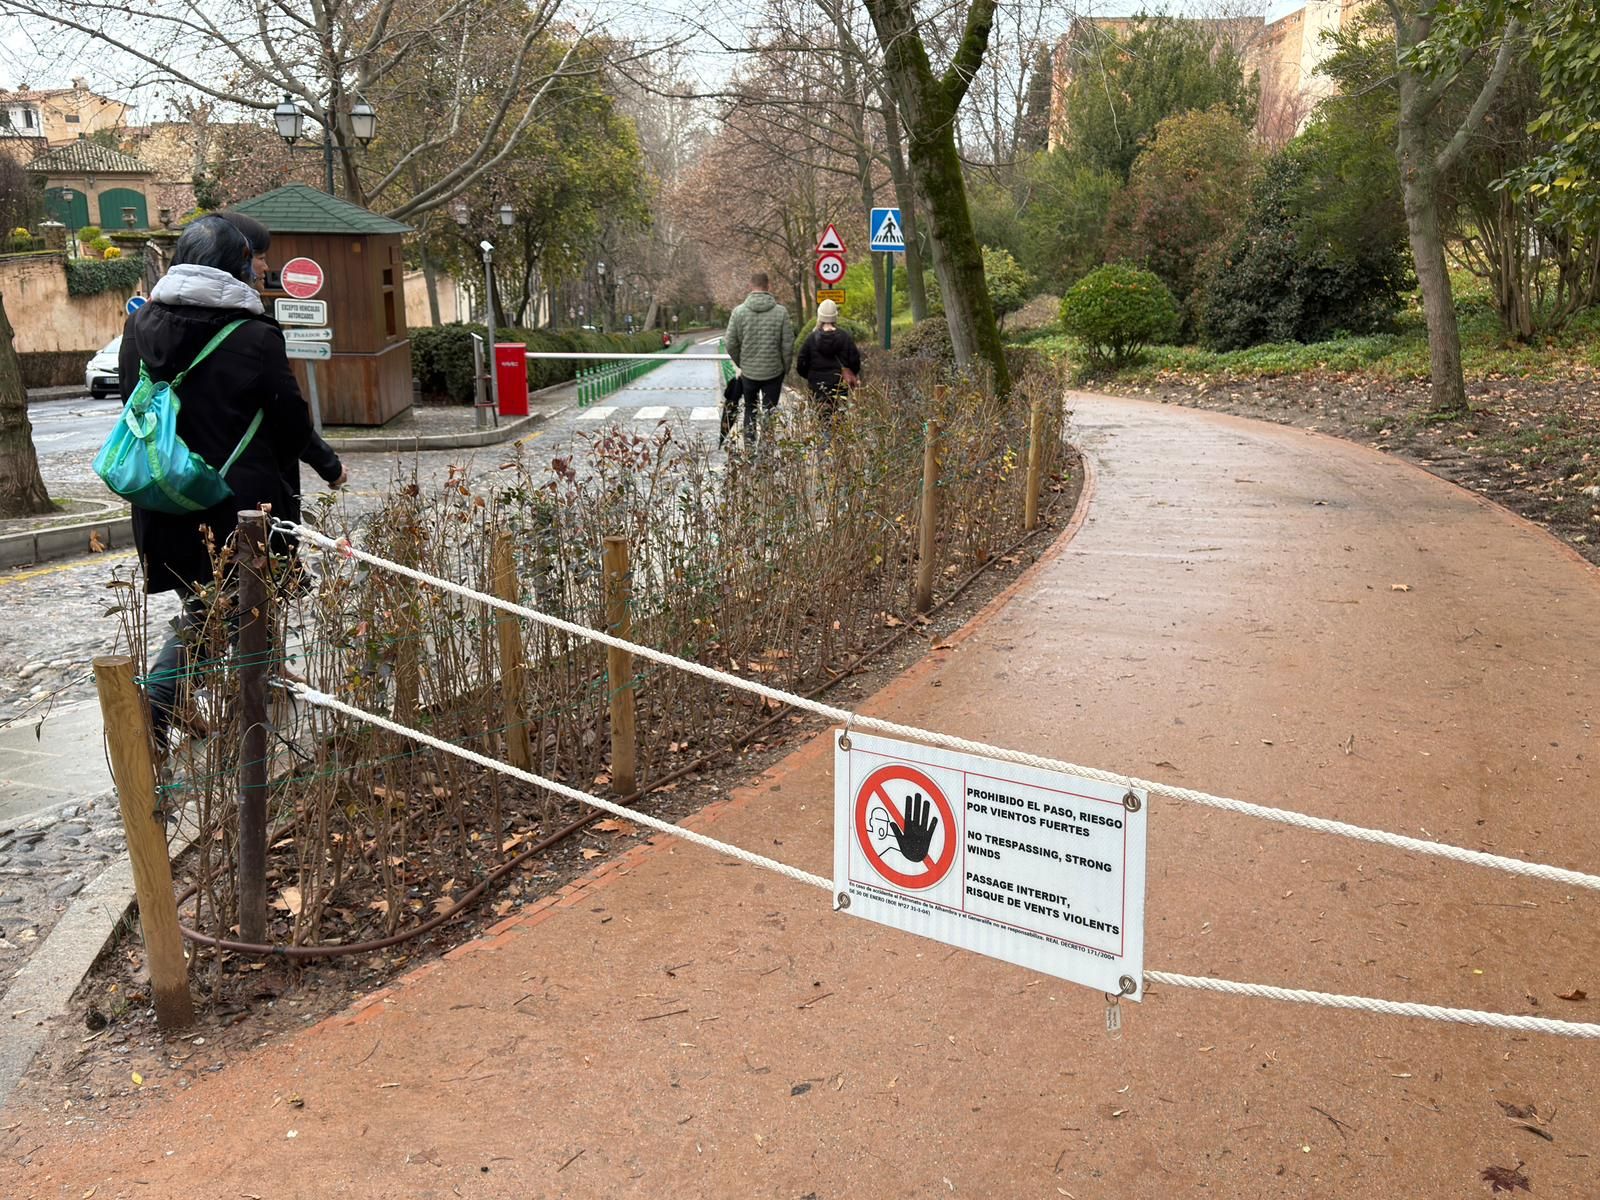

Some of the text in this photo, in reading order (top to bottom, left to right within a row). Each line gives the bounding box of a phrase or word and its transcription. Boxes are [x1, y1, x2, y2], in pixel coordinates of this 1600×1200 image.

[823, 263, 839, 273] 20
[967, 787, 1123, 830] PROHIBIDO EL PASO, RIESGO
[967, 802, 1090, 837] POR VIENTOS FUERTES
[968, 830, 1112, 872] NO TRESPASSING, STRONG
[968, 844, 1001, 860] WINDS
[870, 894, 885, 903] ENERO
[966, 872, 1070, 908] PASSAGE INTERDIT,
[899, 895, 922, 906] Patronato
[935, 905, 958, 916] Alhambra
[1046, 936, 1059, 945] REAL
[1060, 941, 1086, 952] DECRETO
[1087, 948, 1115, 961] 171/2004
[966, 886, 1120, 935] RISQUE DE VENTS VIOLENTS
